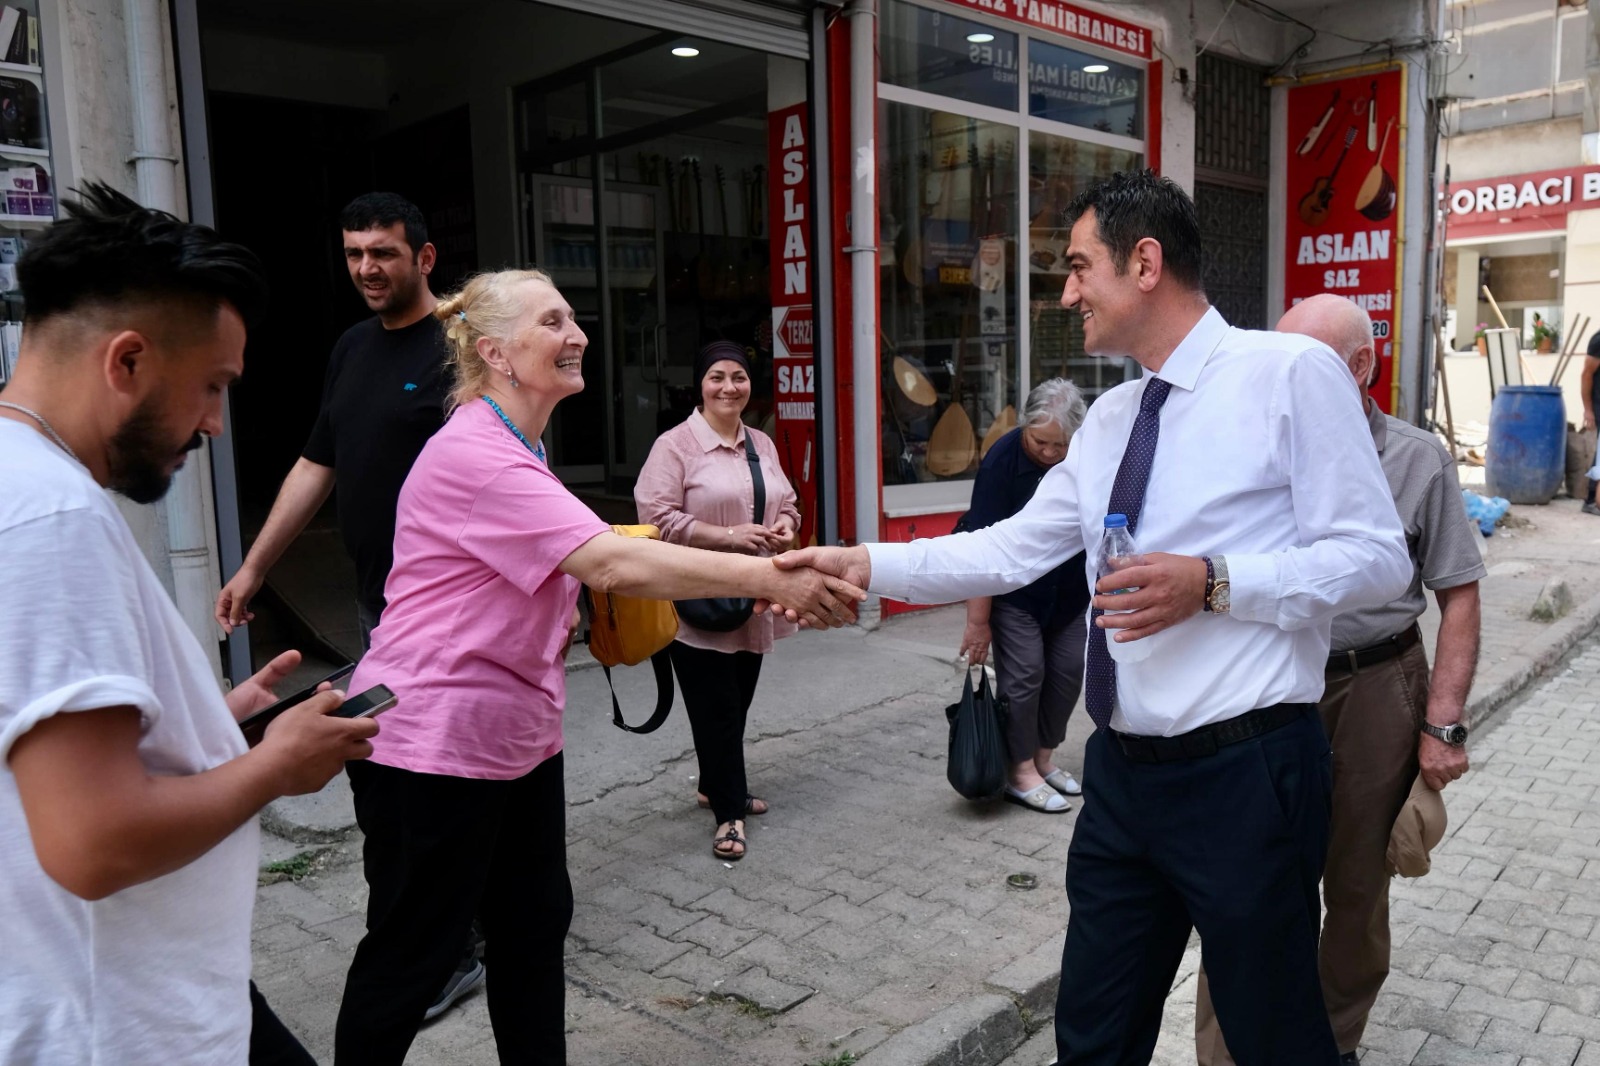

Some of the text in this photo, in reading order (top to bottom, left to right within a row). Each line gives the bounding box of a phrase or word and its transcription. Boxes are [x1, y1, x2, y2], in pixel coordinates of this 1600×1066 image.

[1013, 0, 1145, 53] TAMİRHANESİ
[782, 114, 807, 295] ASLAN
[1296, 229, 1391, 265] ASLAN
[1324, 268, 1360, 289] SAZ
[778, 365, 815, 394] SAZ
